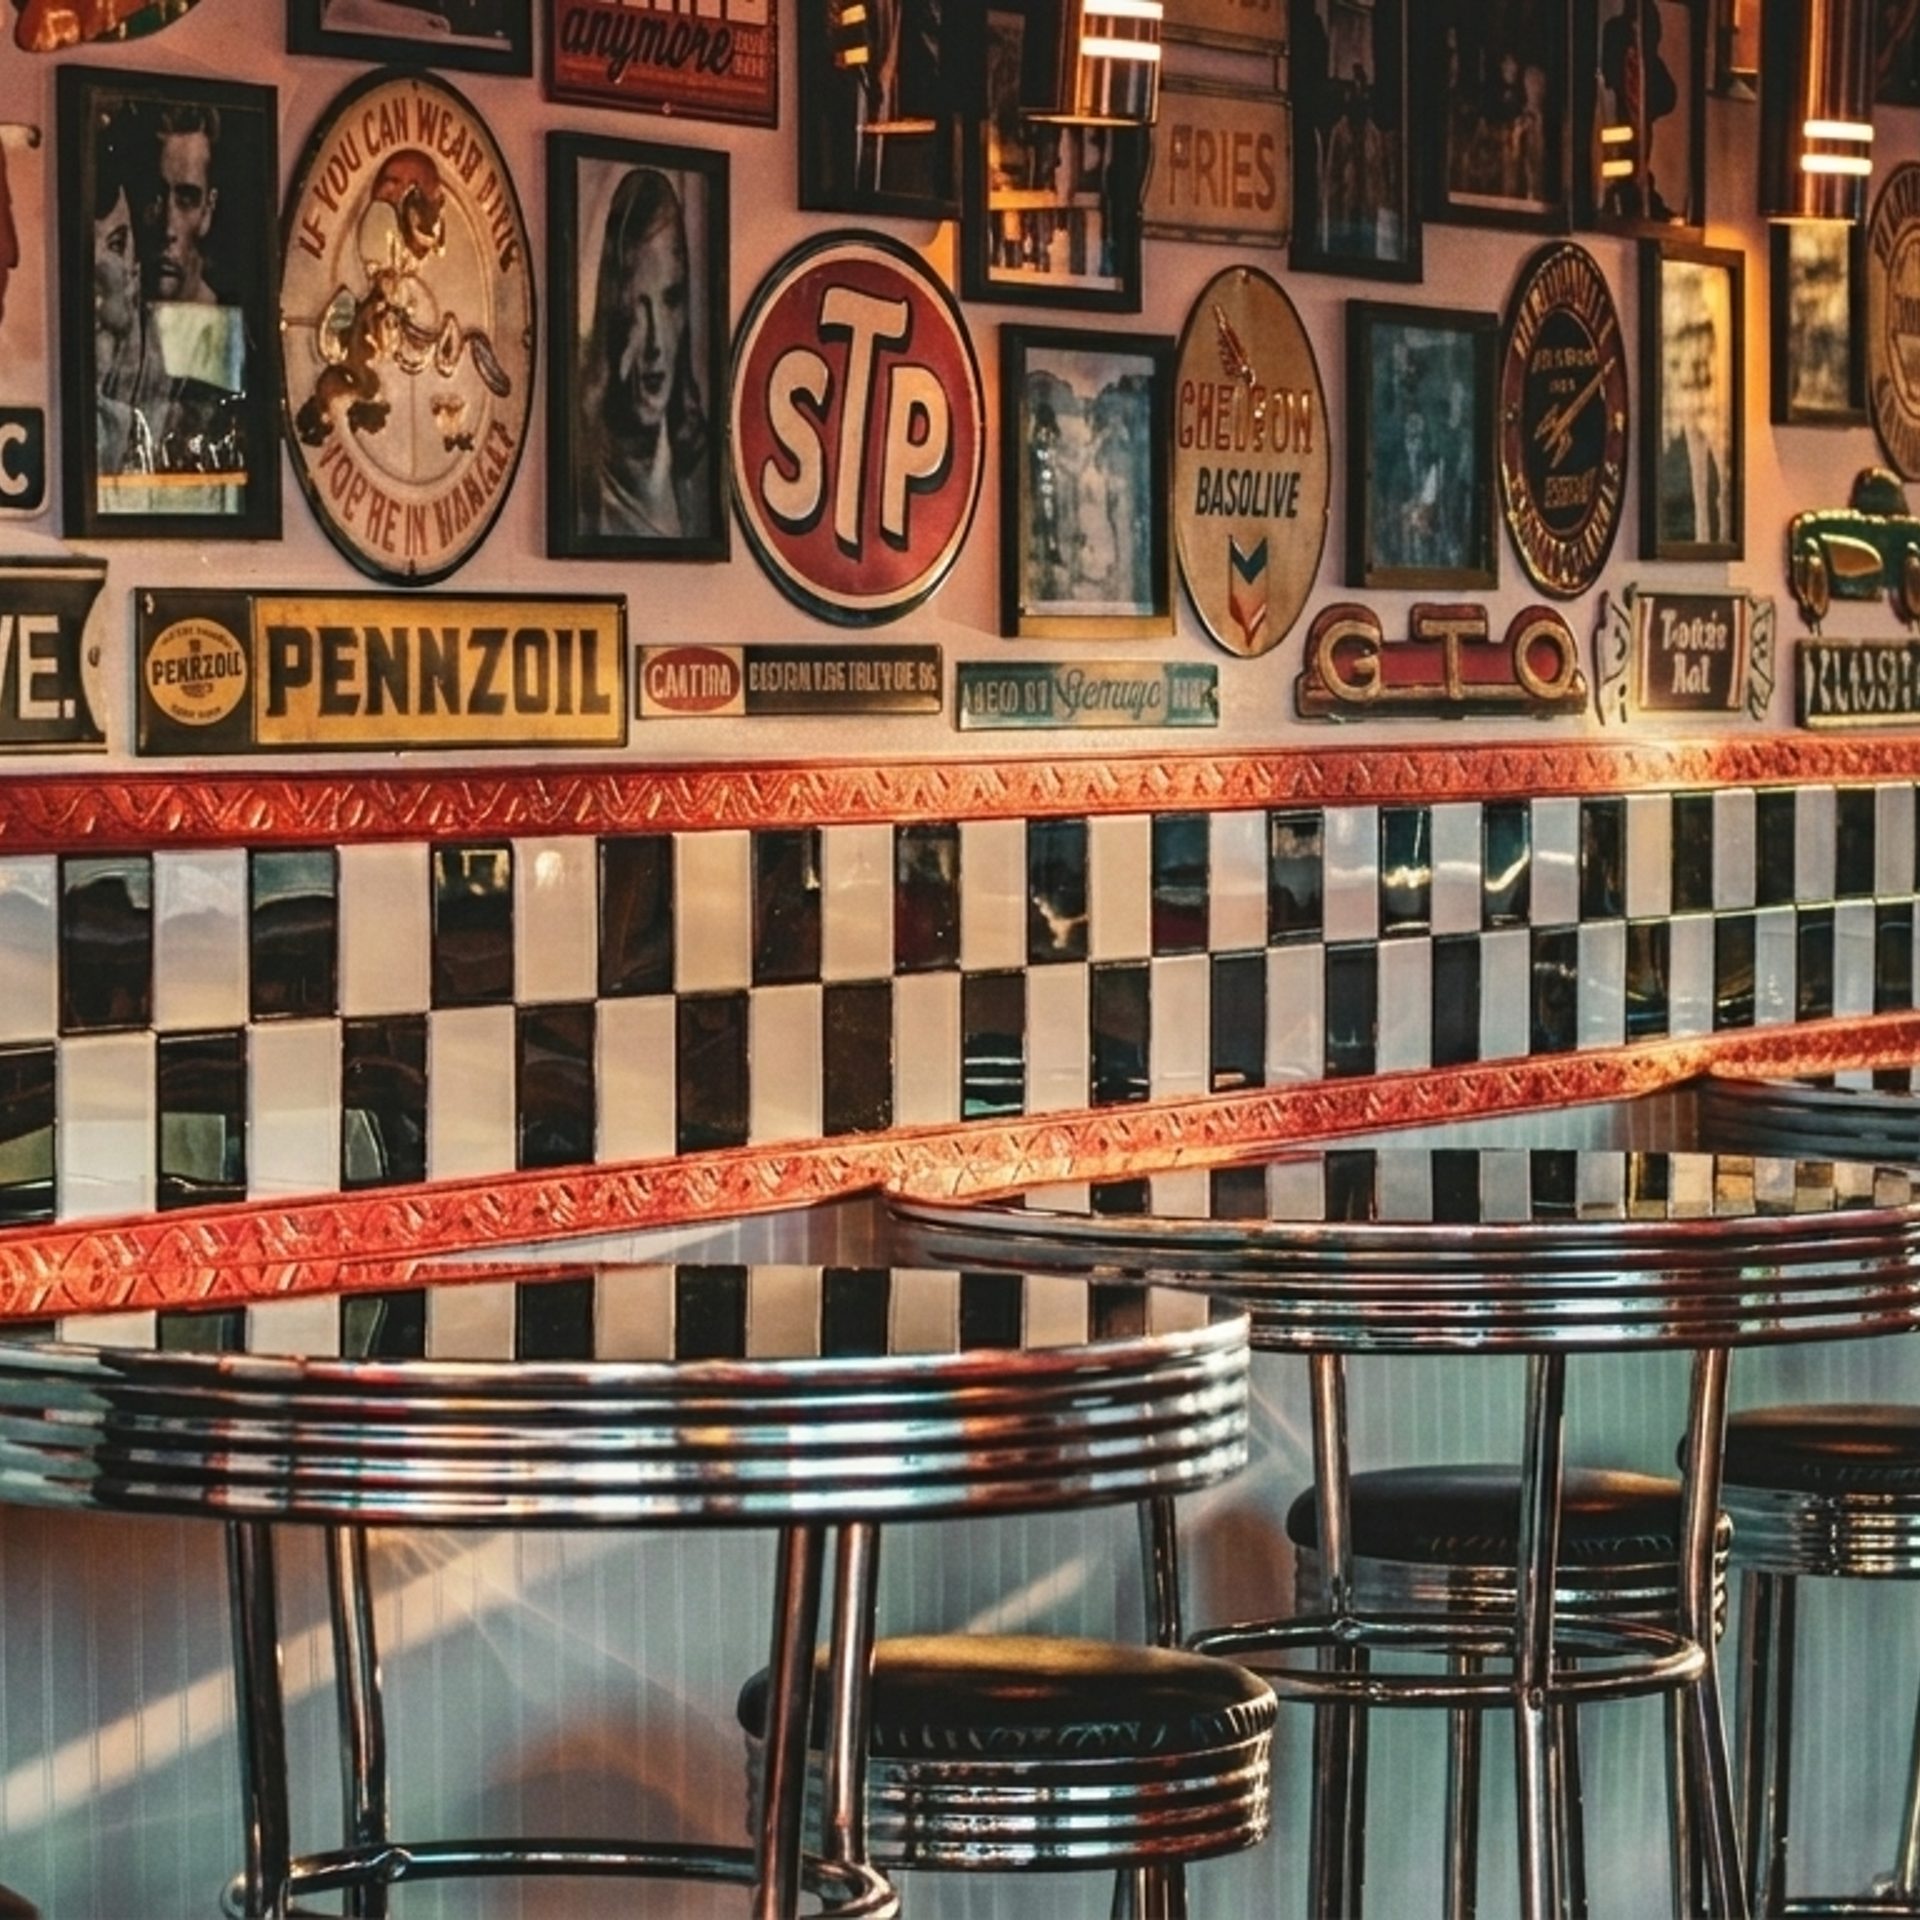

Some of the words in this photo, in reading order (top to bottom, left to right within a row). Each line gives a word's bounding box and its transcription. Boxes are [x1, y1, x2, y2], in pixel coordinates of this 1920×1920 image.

[561, 7, 733, 83] anymore
[313, 131, 362, 213] YOU
[362, 97, 409, 157] CAN
[1169, 124, 1276, 212] FRIES
[761, 284, 953, 562] STP
[265, 626, 611, 717] PENNZOIL
[1318, 619, 1577, 701] GTO
